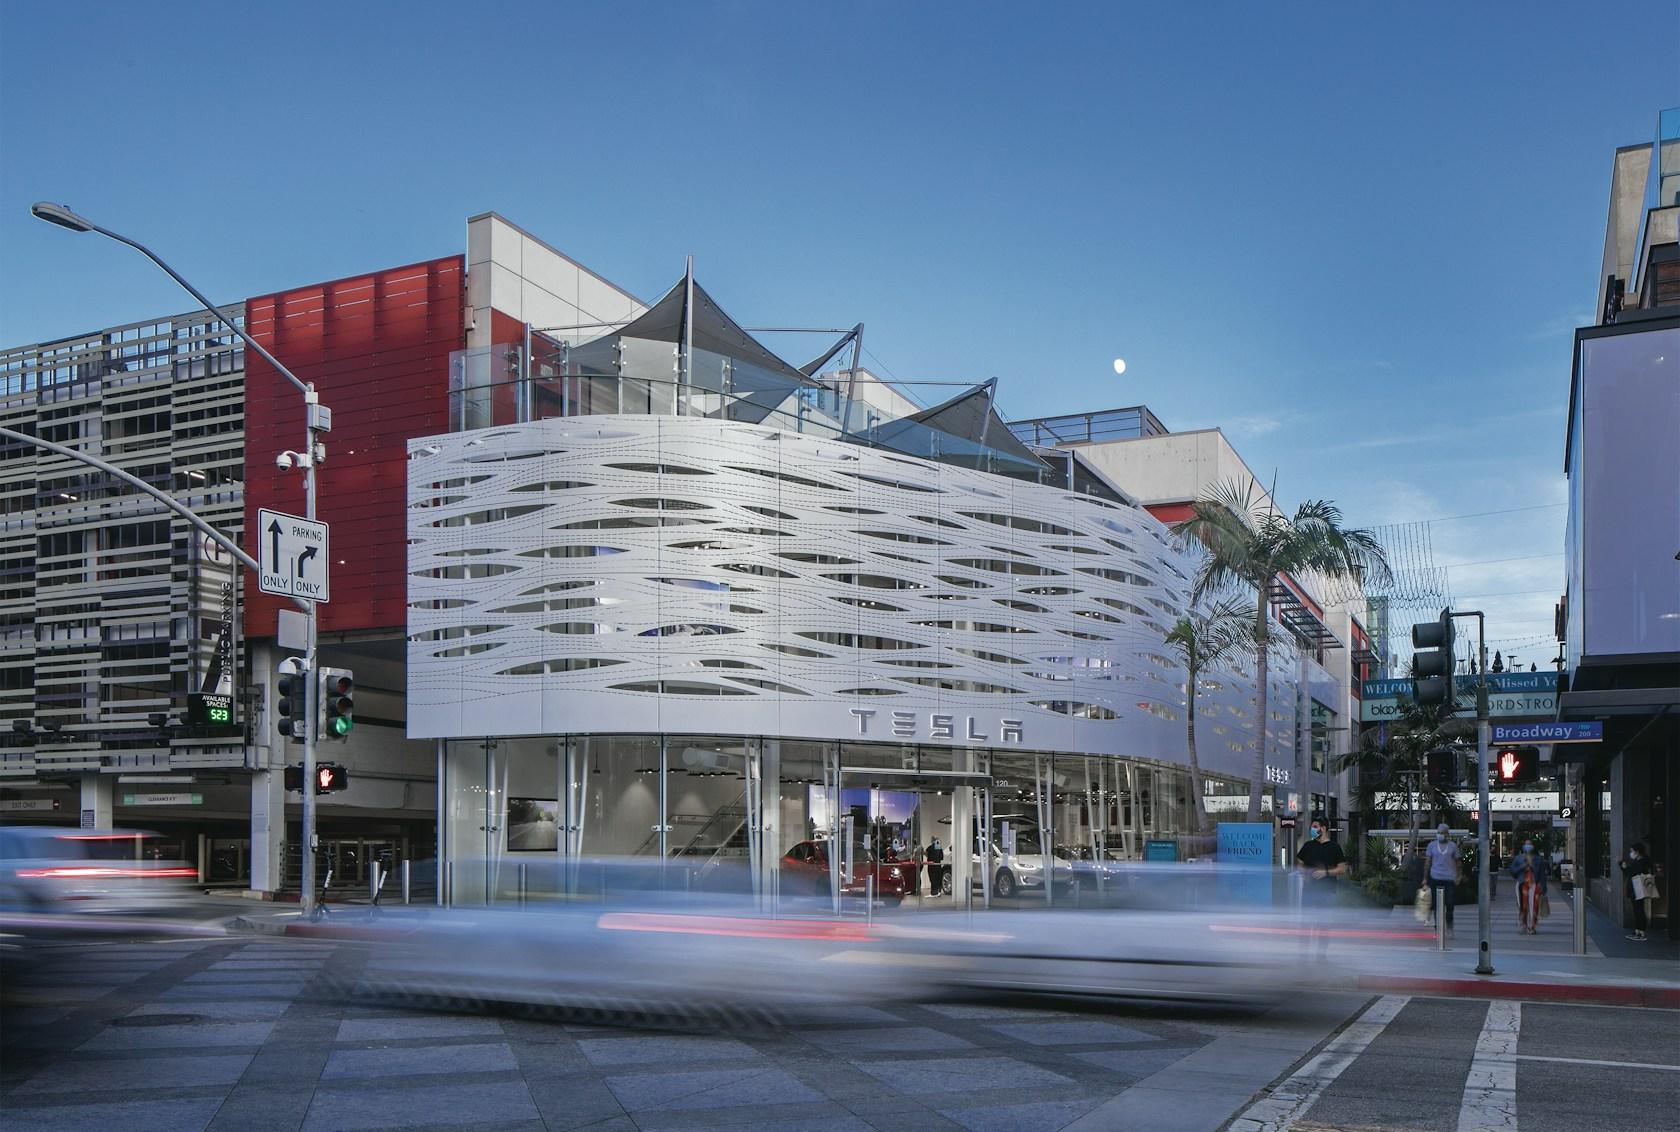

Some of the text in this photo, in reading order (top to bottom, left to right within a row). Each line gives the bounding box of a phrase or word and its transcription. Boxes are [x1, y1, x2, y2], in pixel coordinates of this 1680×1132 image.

[292, 526, 322, 541] PARKING
[263, 576, 288, 589] ONLY
[296, 581, 320, 594] ONLY
[221, 582, 232, 683] PUBLIC PARKING
[202, 695, 230, 703] AVAILABLE
[1488, 698, 1557, 711] ORDSTRO
[210, 709, 228, 720] 523
[849, 708, 1023, 743] TESLA
[1496, 725, 1572, 739] Broadway
[995, 780, 1008, 788] 120
[1222, 832, 1266, 841] WELCOME
[1227, 848, 1262, 856] FRIEND
